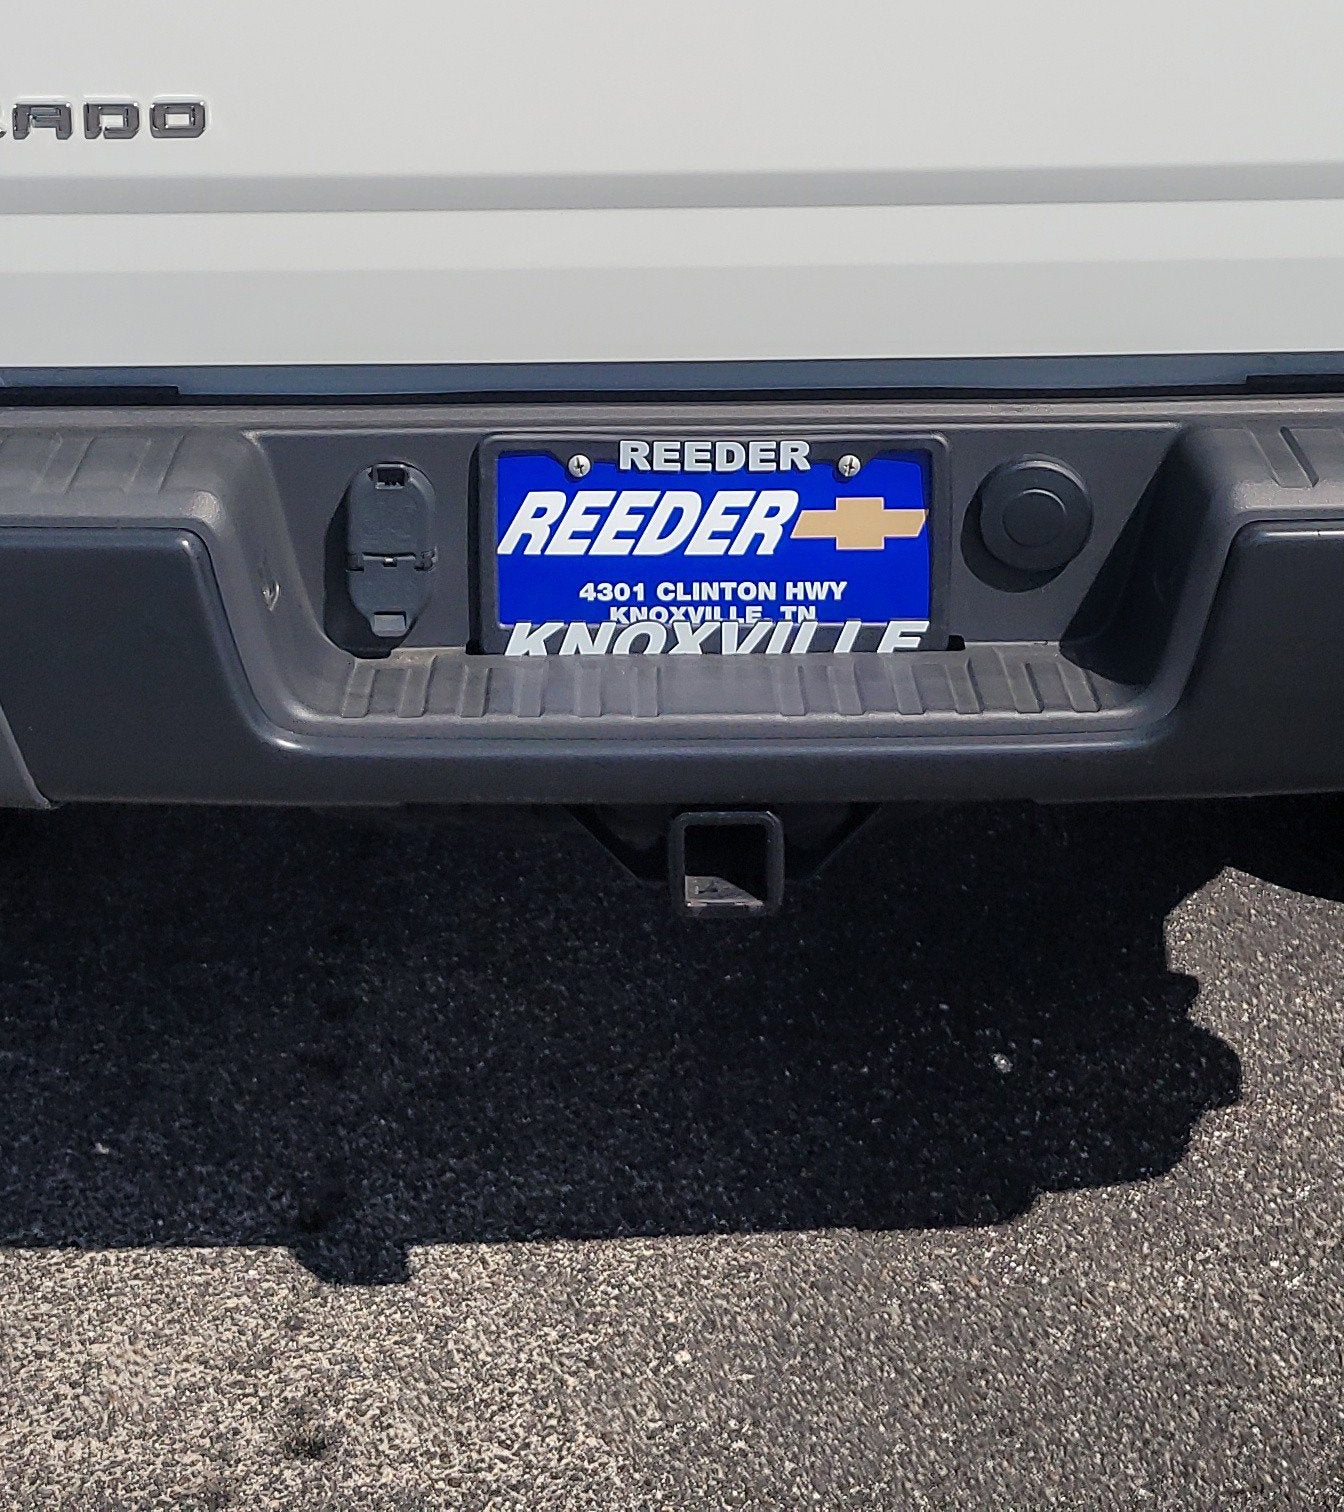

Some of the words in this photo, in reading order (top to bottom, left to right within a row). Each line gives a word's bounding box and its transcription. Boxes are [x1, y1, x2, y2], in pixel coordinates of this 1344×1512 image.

[619, 440, 812, 472] REEDER
[497, 490, 800, 556] REEDER
[579, 582, 646, 601] 4301
[656, 581, 777, 601] CLINTON
[785, 581, 848, 601] HWY
[609, 605, 771, 624] KNOXVILLE
[779, 605, 817, 624] TN
